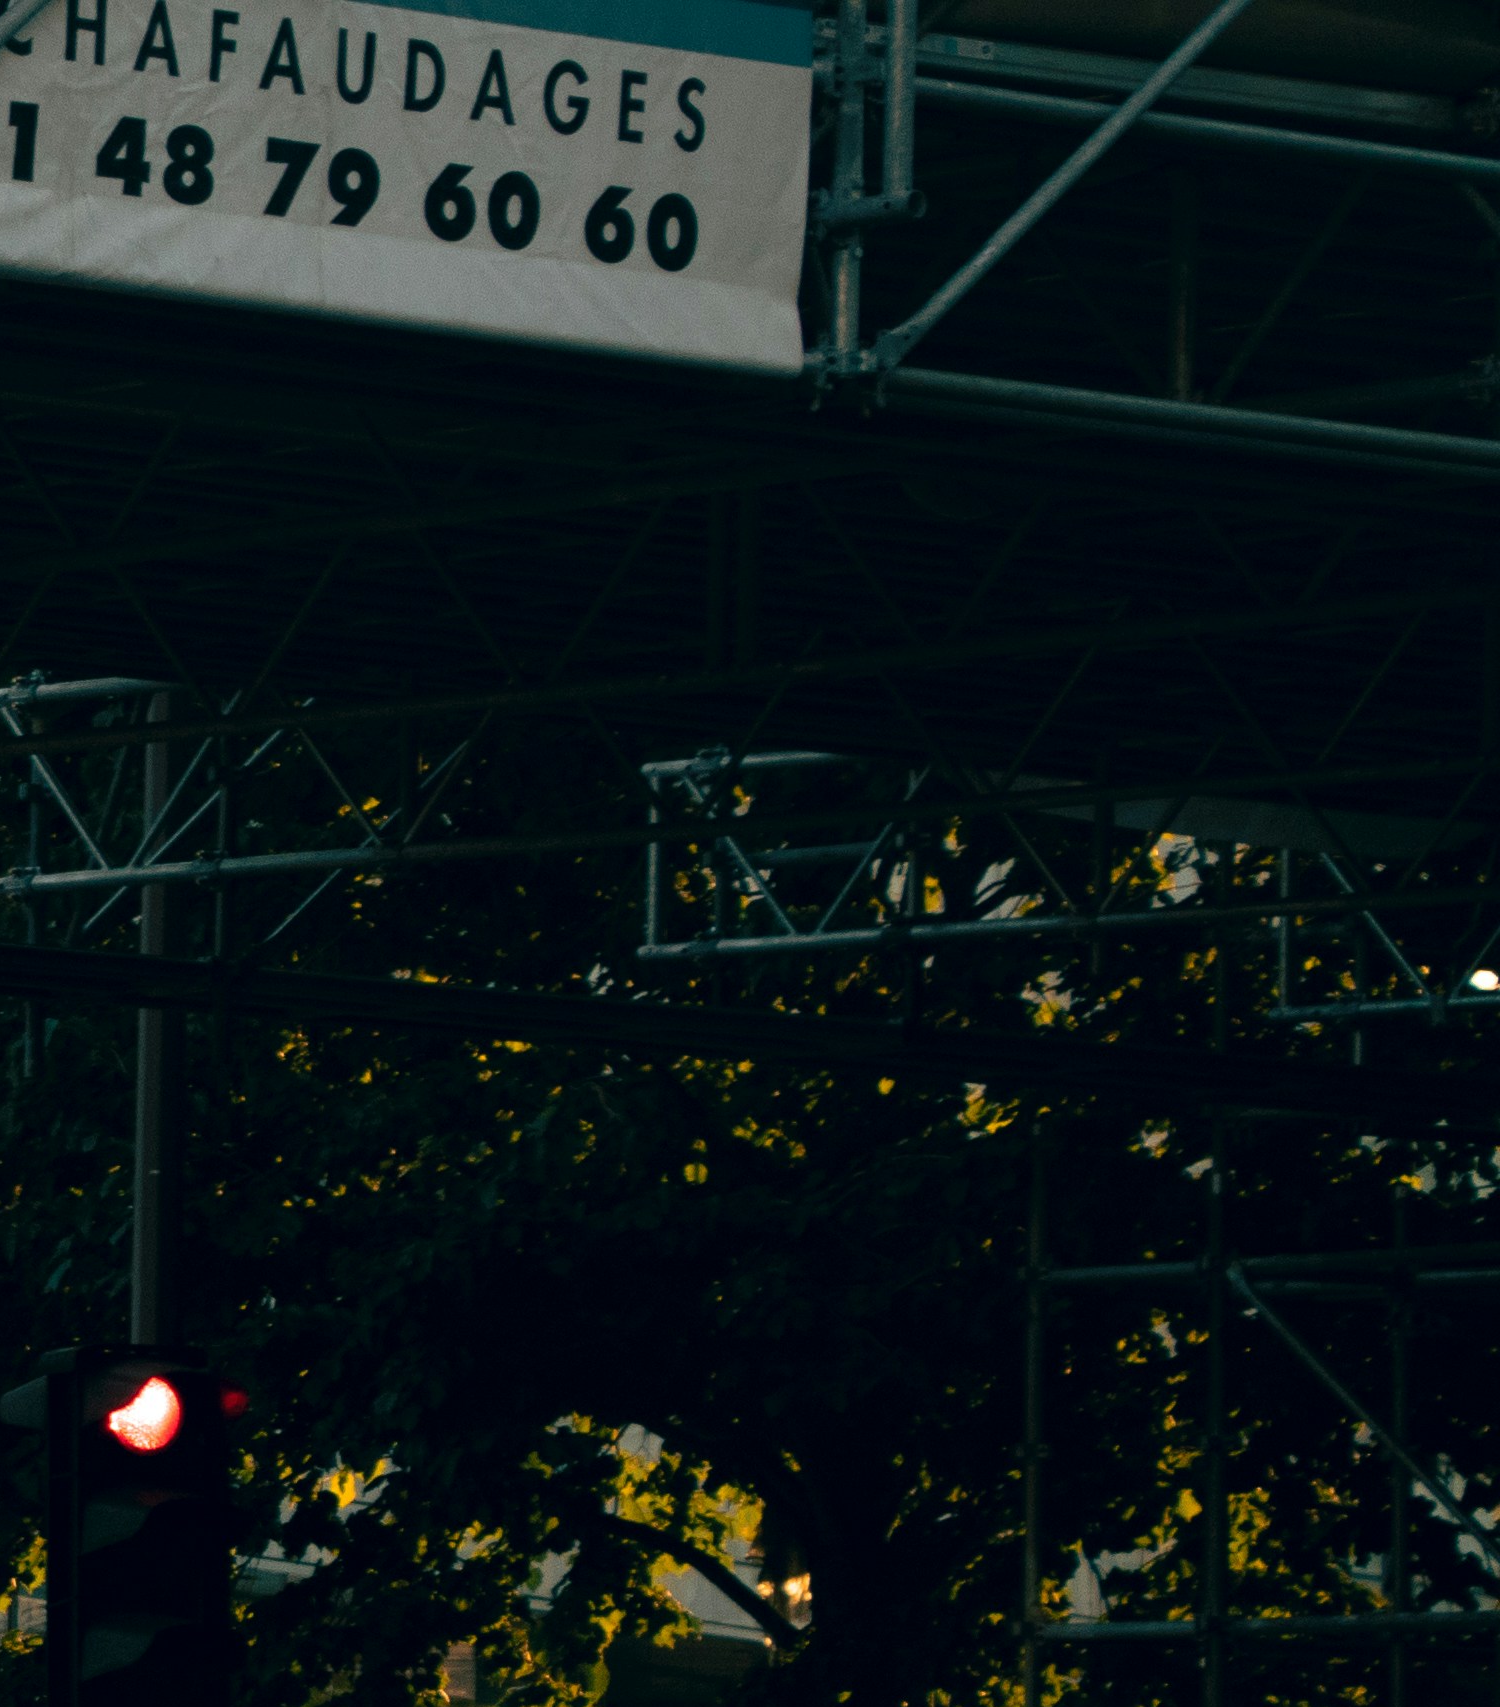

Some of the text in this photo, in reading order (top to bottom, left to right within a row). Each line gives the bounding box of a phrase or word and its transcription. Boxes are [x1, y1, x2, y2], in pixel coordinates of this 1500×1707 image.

[96, 115, 215, 206] 48
[261, 136, 381, 226] 79
[424, 162, 542, 251] 60
[583, 186, 701, 273] 60
